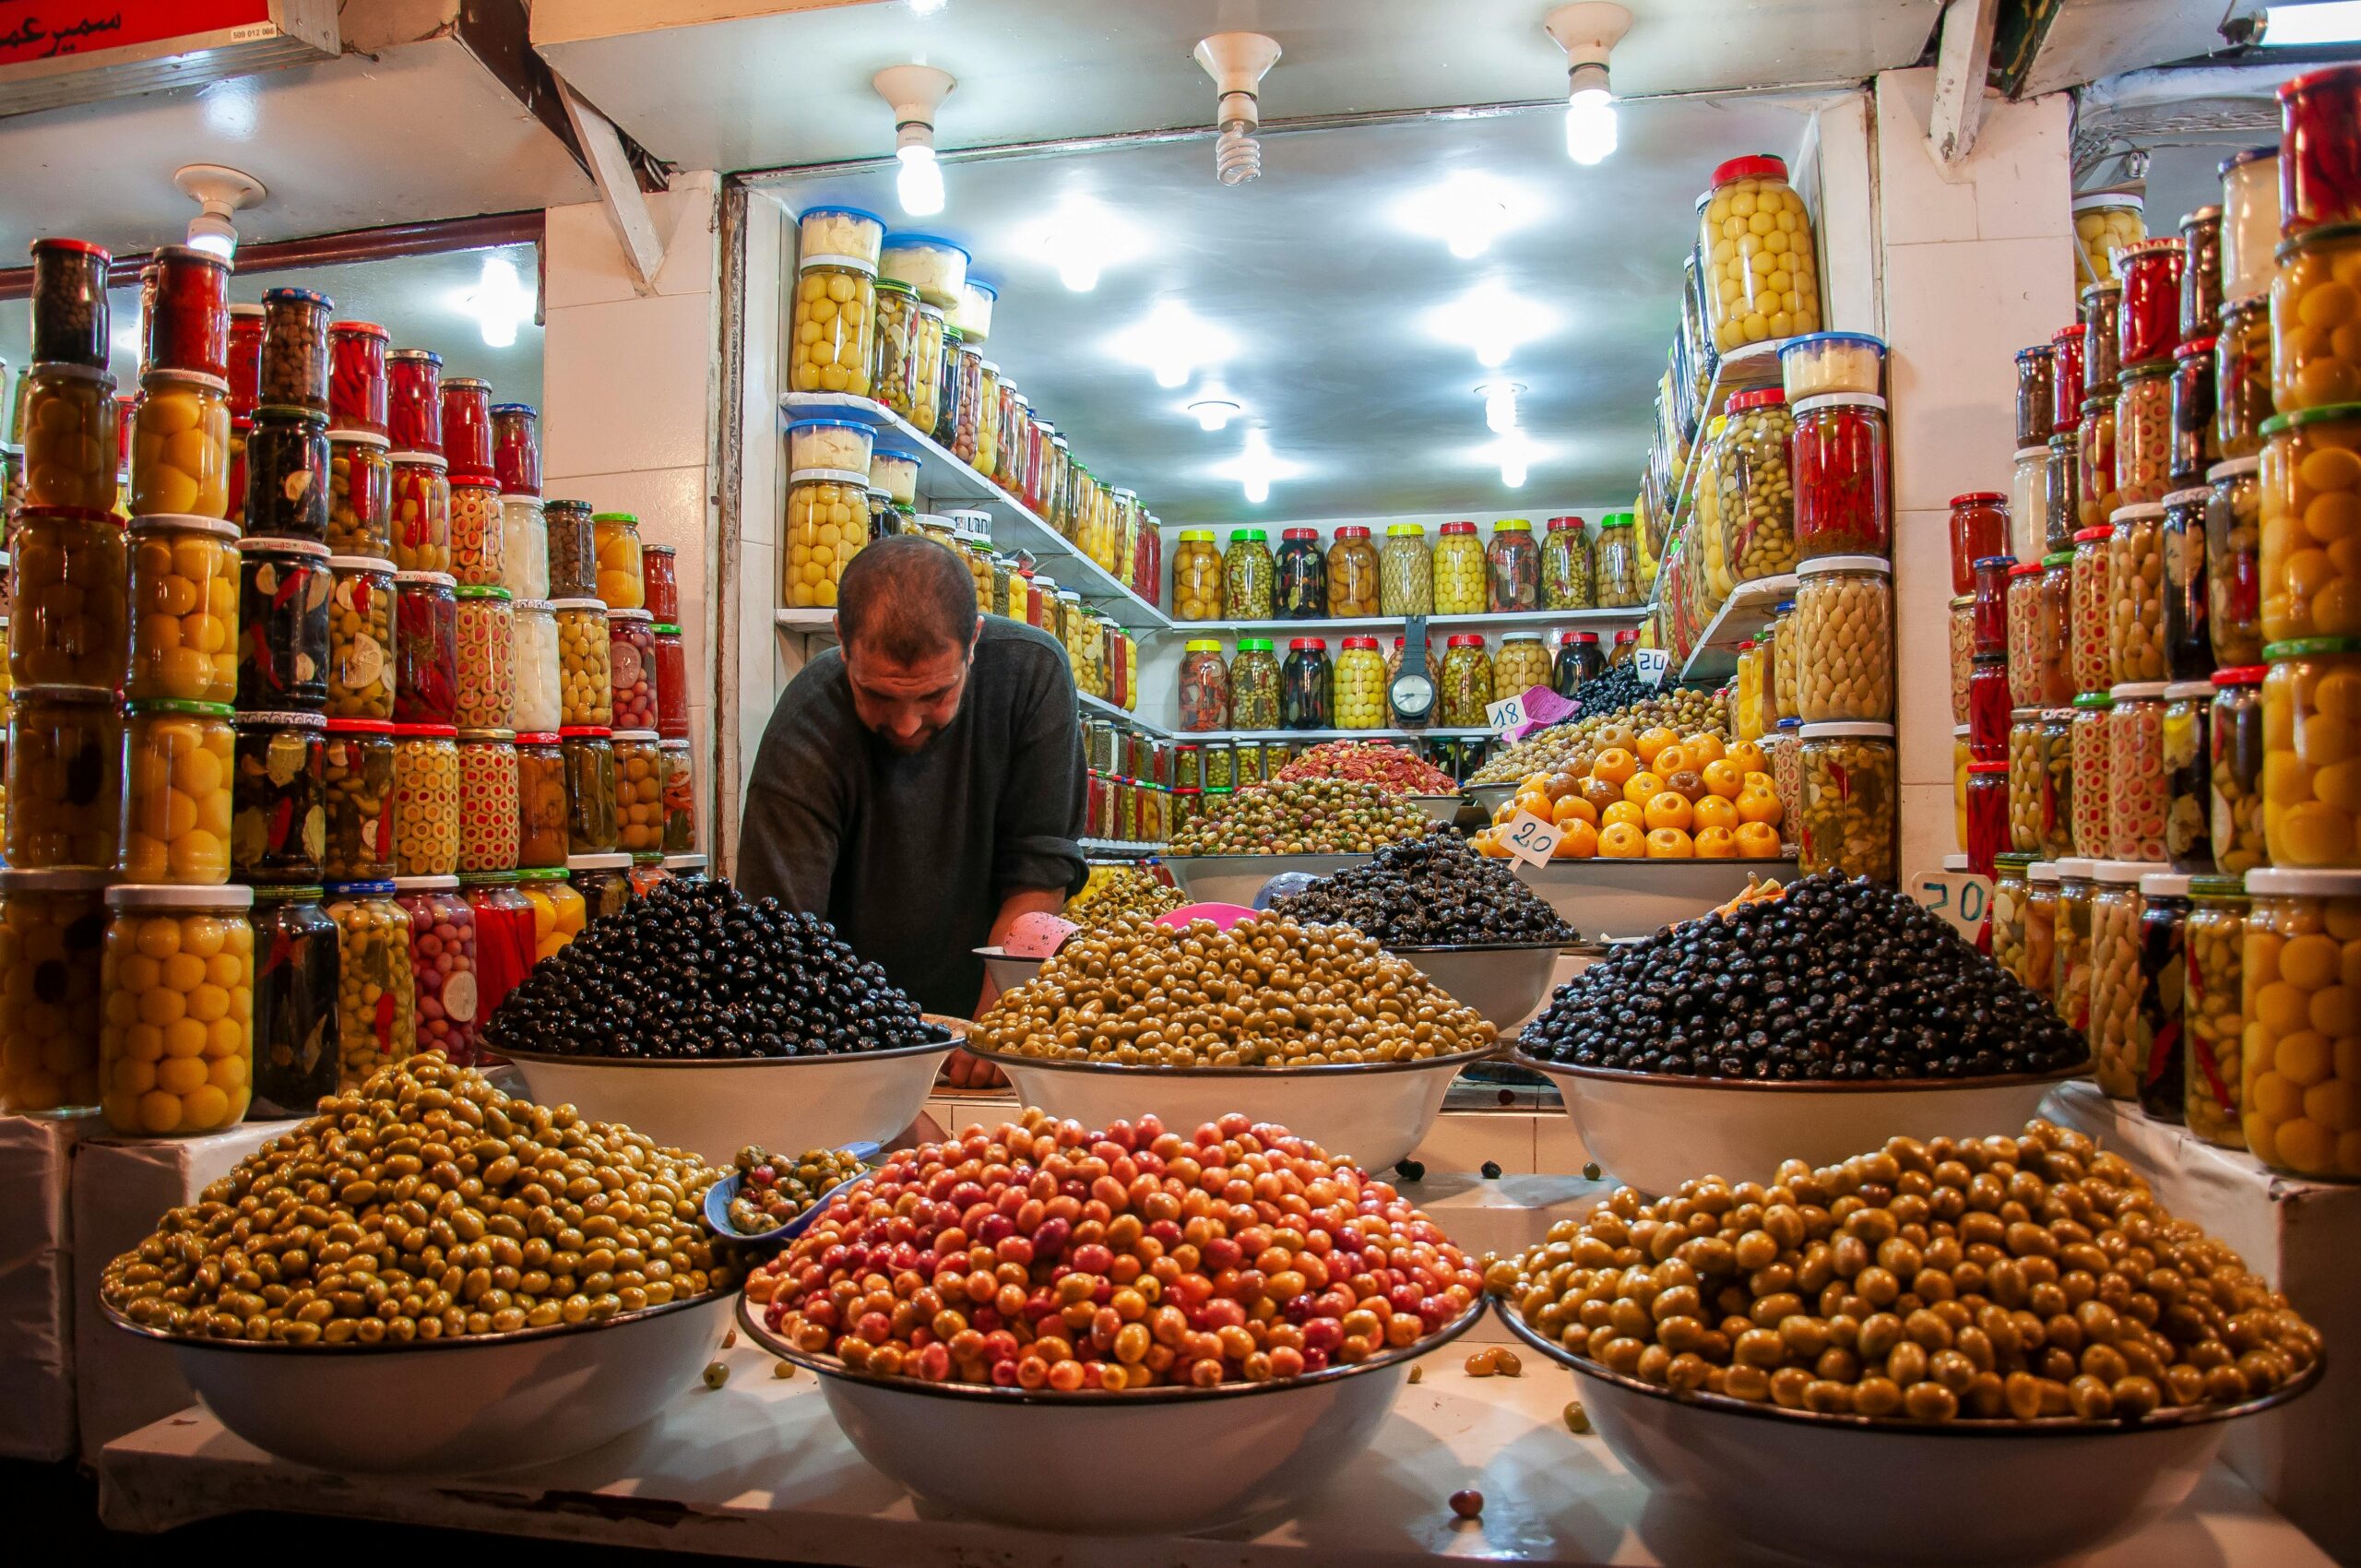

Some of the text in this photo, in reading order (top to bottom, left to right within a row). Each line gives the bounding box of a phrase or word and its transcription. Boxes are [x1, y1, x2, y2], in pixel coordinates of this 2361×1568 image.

[1639, 653, 1666, 671] 20
[1493, 702, 1519, 729] 18
[1513, 822, 1552, 852] 20
